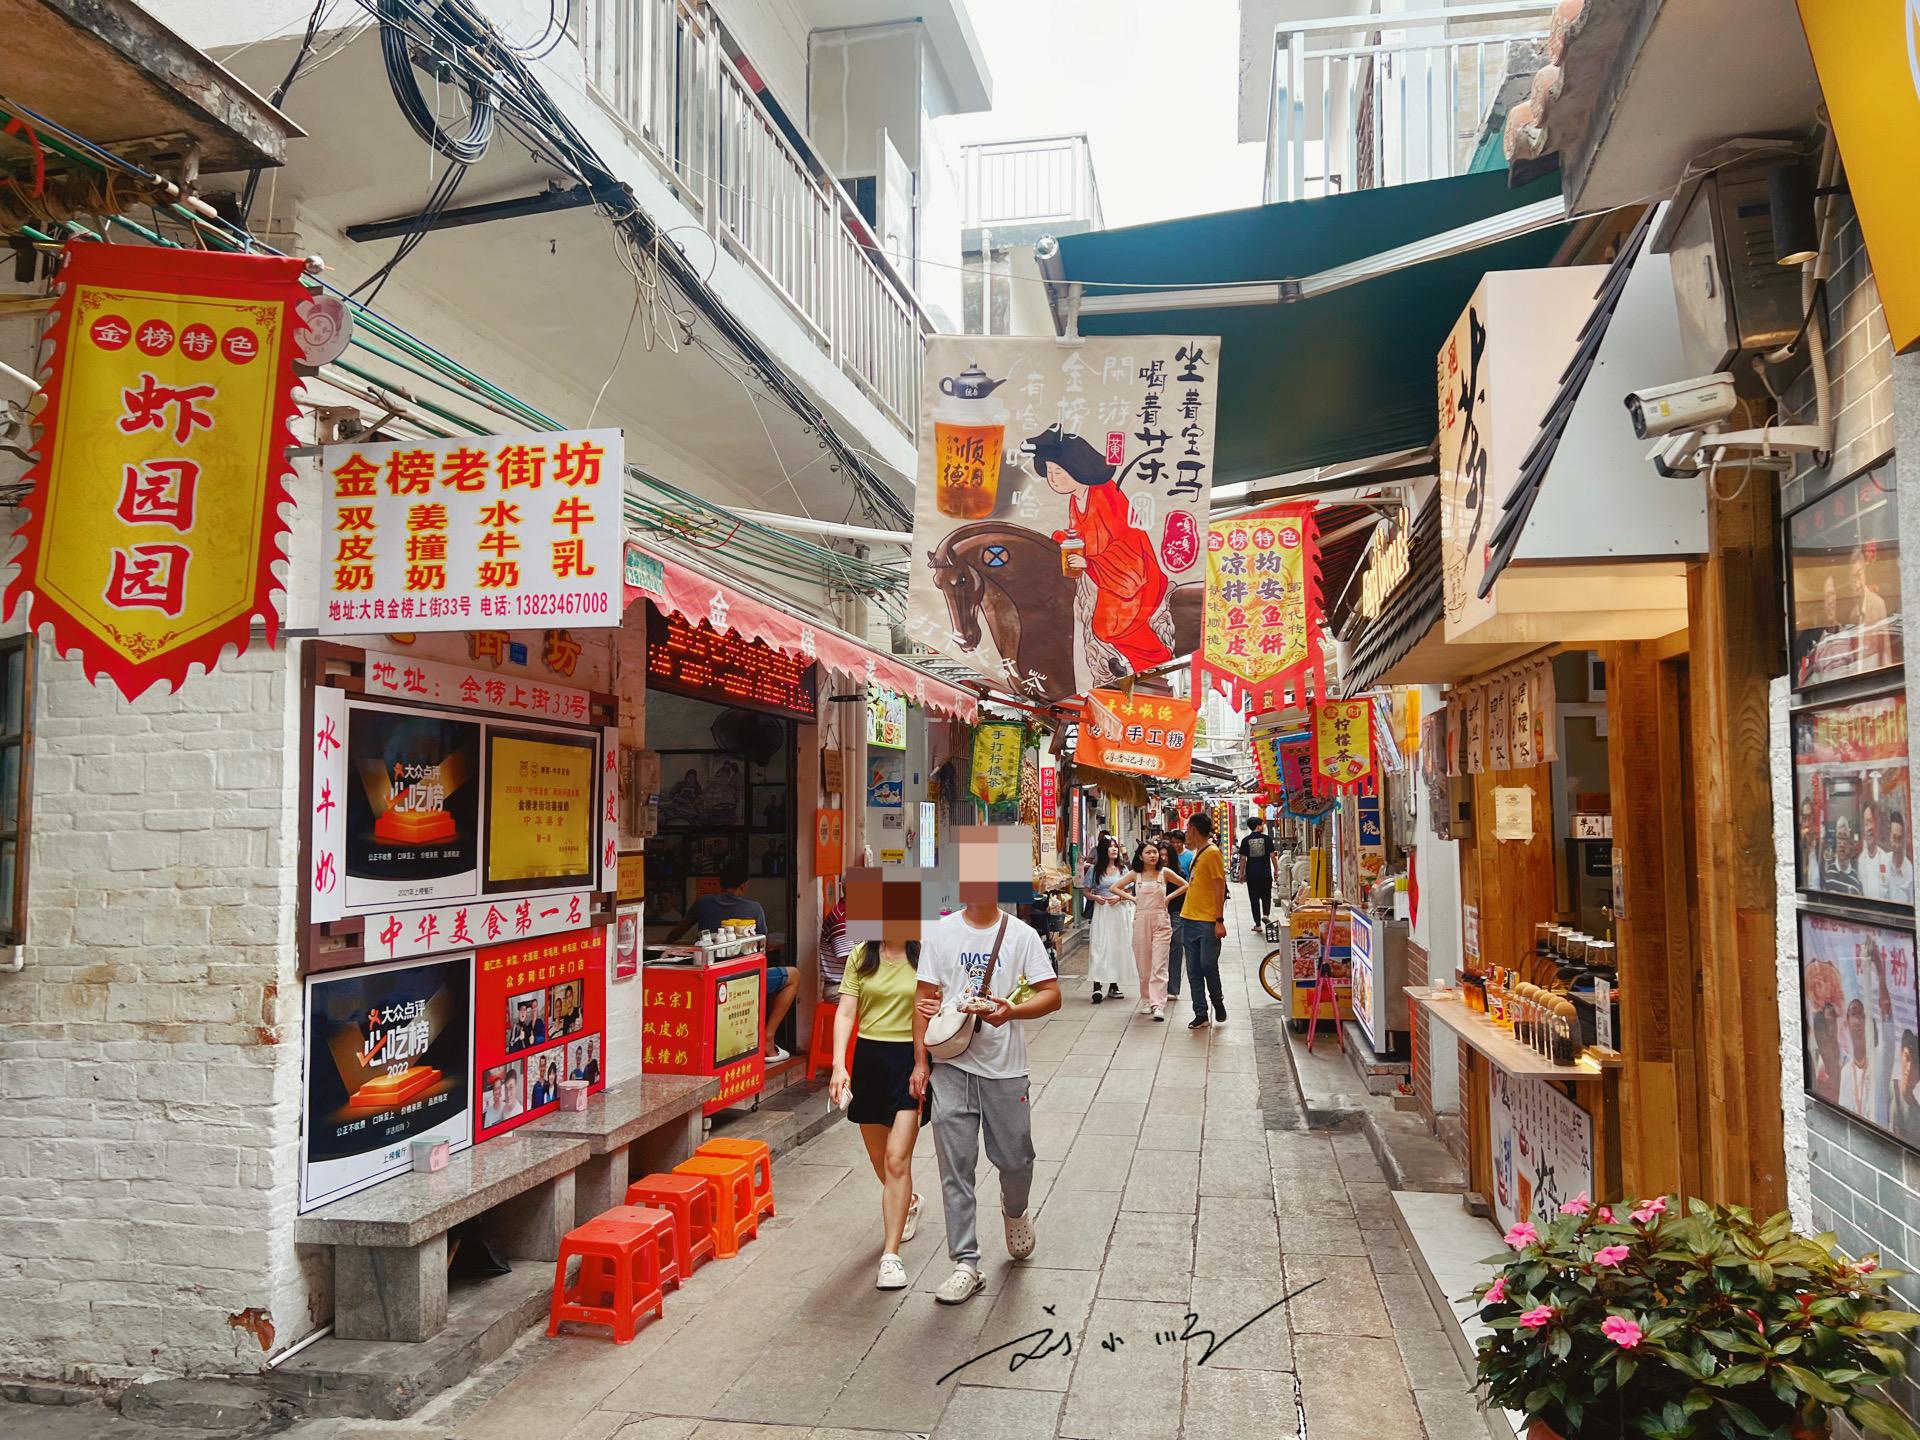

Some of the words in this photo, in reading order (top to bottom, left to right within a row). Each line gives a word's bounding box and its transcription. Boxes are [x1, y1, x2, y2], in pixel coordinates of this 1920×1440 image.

[93, 321, 258, 358] 金榜特色
[1056, 351, 1101, 441] 金榜
[1166, 341, 1210, 503] 坐着宝马
[1117, 359, 1173, 492] 喝着茶
[106, 374, 216, 616] 虾园园
[332, 441, 605, 499] 金榜老街坊
[334, 504, 376, 593] 双皮奶
[405, 503, 448, 592] 姜撞奶
[478, 501, 521, 590] 水牛奶
[552, 496, 596, 578] 牛乳
[1207, 527, 1301, 551] 金榜特色
[328, 596, 472, 621] 地址:大良金榜上街33号
[480, 594, 511, 616] 电话:
[516, 591, 608, 616] 13823467008
[1220, 551, 1252, 657] 凉拌鱼皮
[1255, 549, 1287, 656] 均安鱼饼
[986, 729, 1006, 788] 手打柠檬茶
[1086, 722, 1184, 748] 传手工糖
[1334, 718, 1354, 763] 柠檬茶
[315, 715, 341, 895] 水牛奶
[604, 748, 618, 871] 双皮奶
[378, 894, 582, 959] 中华美食第一名
[505, 958, 585, 989] 众多网红打卡门店
[643, 988, 692, 1010] 【正宗】
[380, 999, 426, 1025] 大众点评
[643, 1020, 689, 1038] 双皮奶
[357, 1020, 430, 1068] 必吃榜
[386, 1061, 409, 1079] 2022
[643, 1045, 688, 1066] 姜撞奶
[336, 1119, 366, 1137] 公正不收费
[372, 1110, 395, 1125] 口味至上
